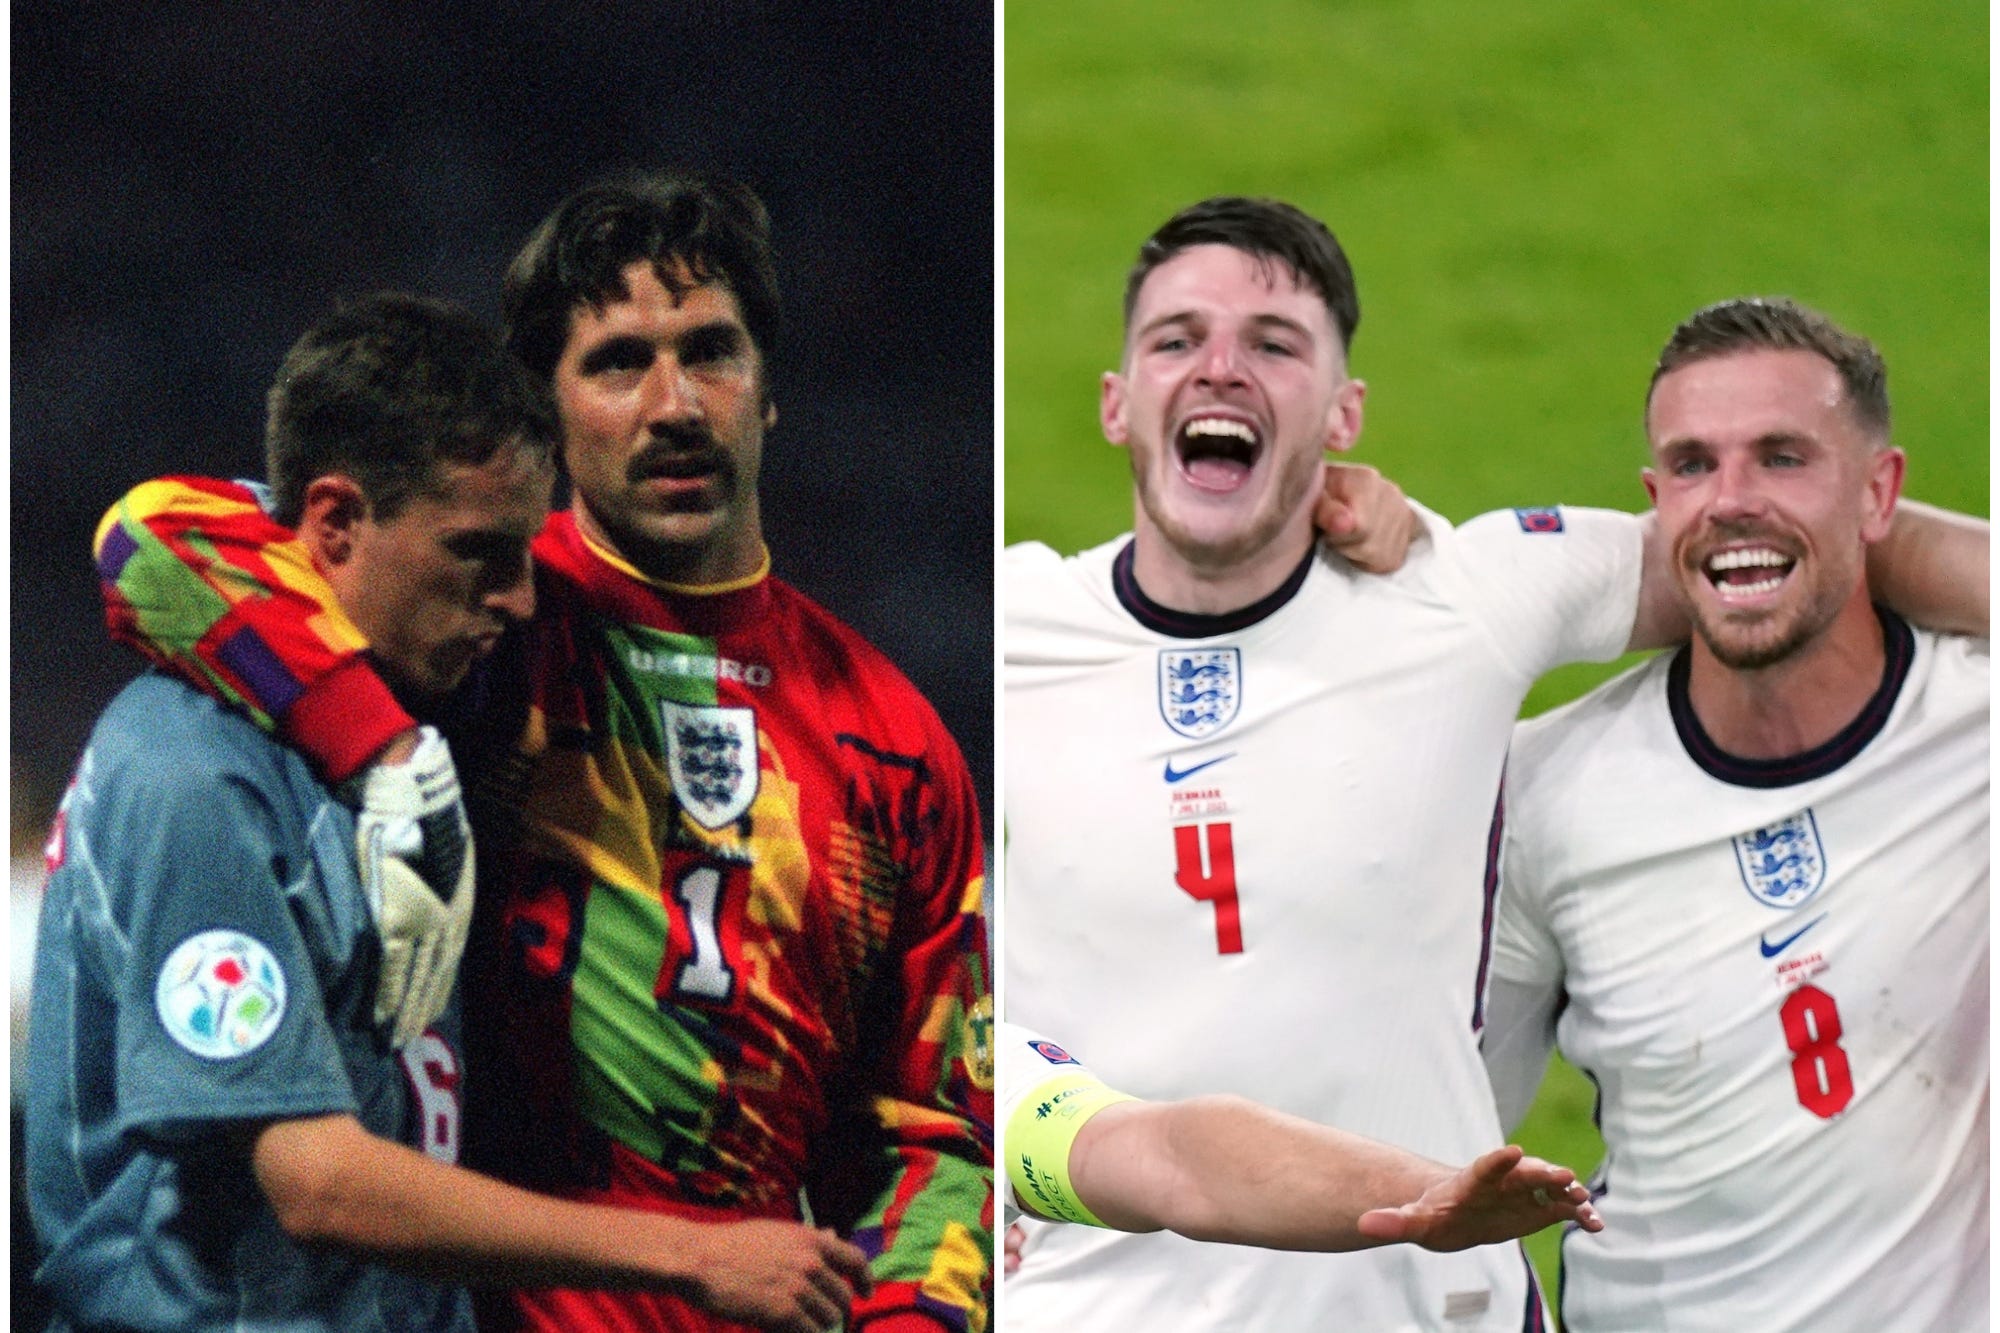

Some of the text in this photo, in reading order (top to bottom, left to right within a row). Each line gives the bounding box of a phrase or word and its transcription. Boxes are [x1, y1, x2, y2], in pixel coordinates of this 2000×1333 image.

[676, 864, 736, 1002] 1
[1174, 823, 1244, 955] 4
[397, 1028, 462, 1166] 6
[1779, 984, 1855, 1120] 8
